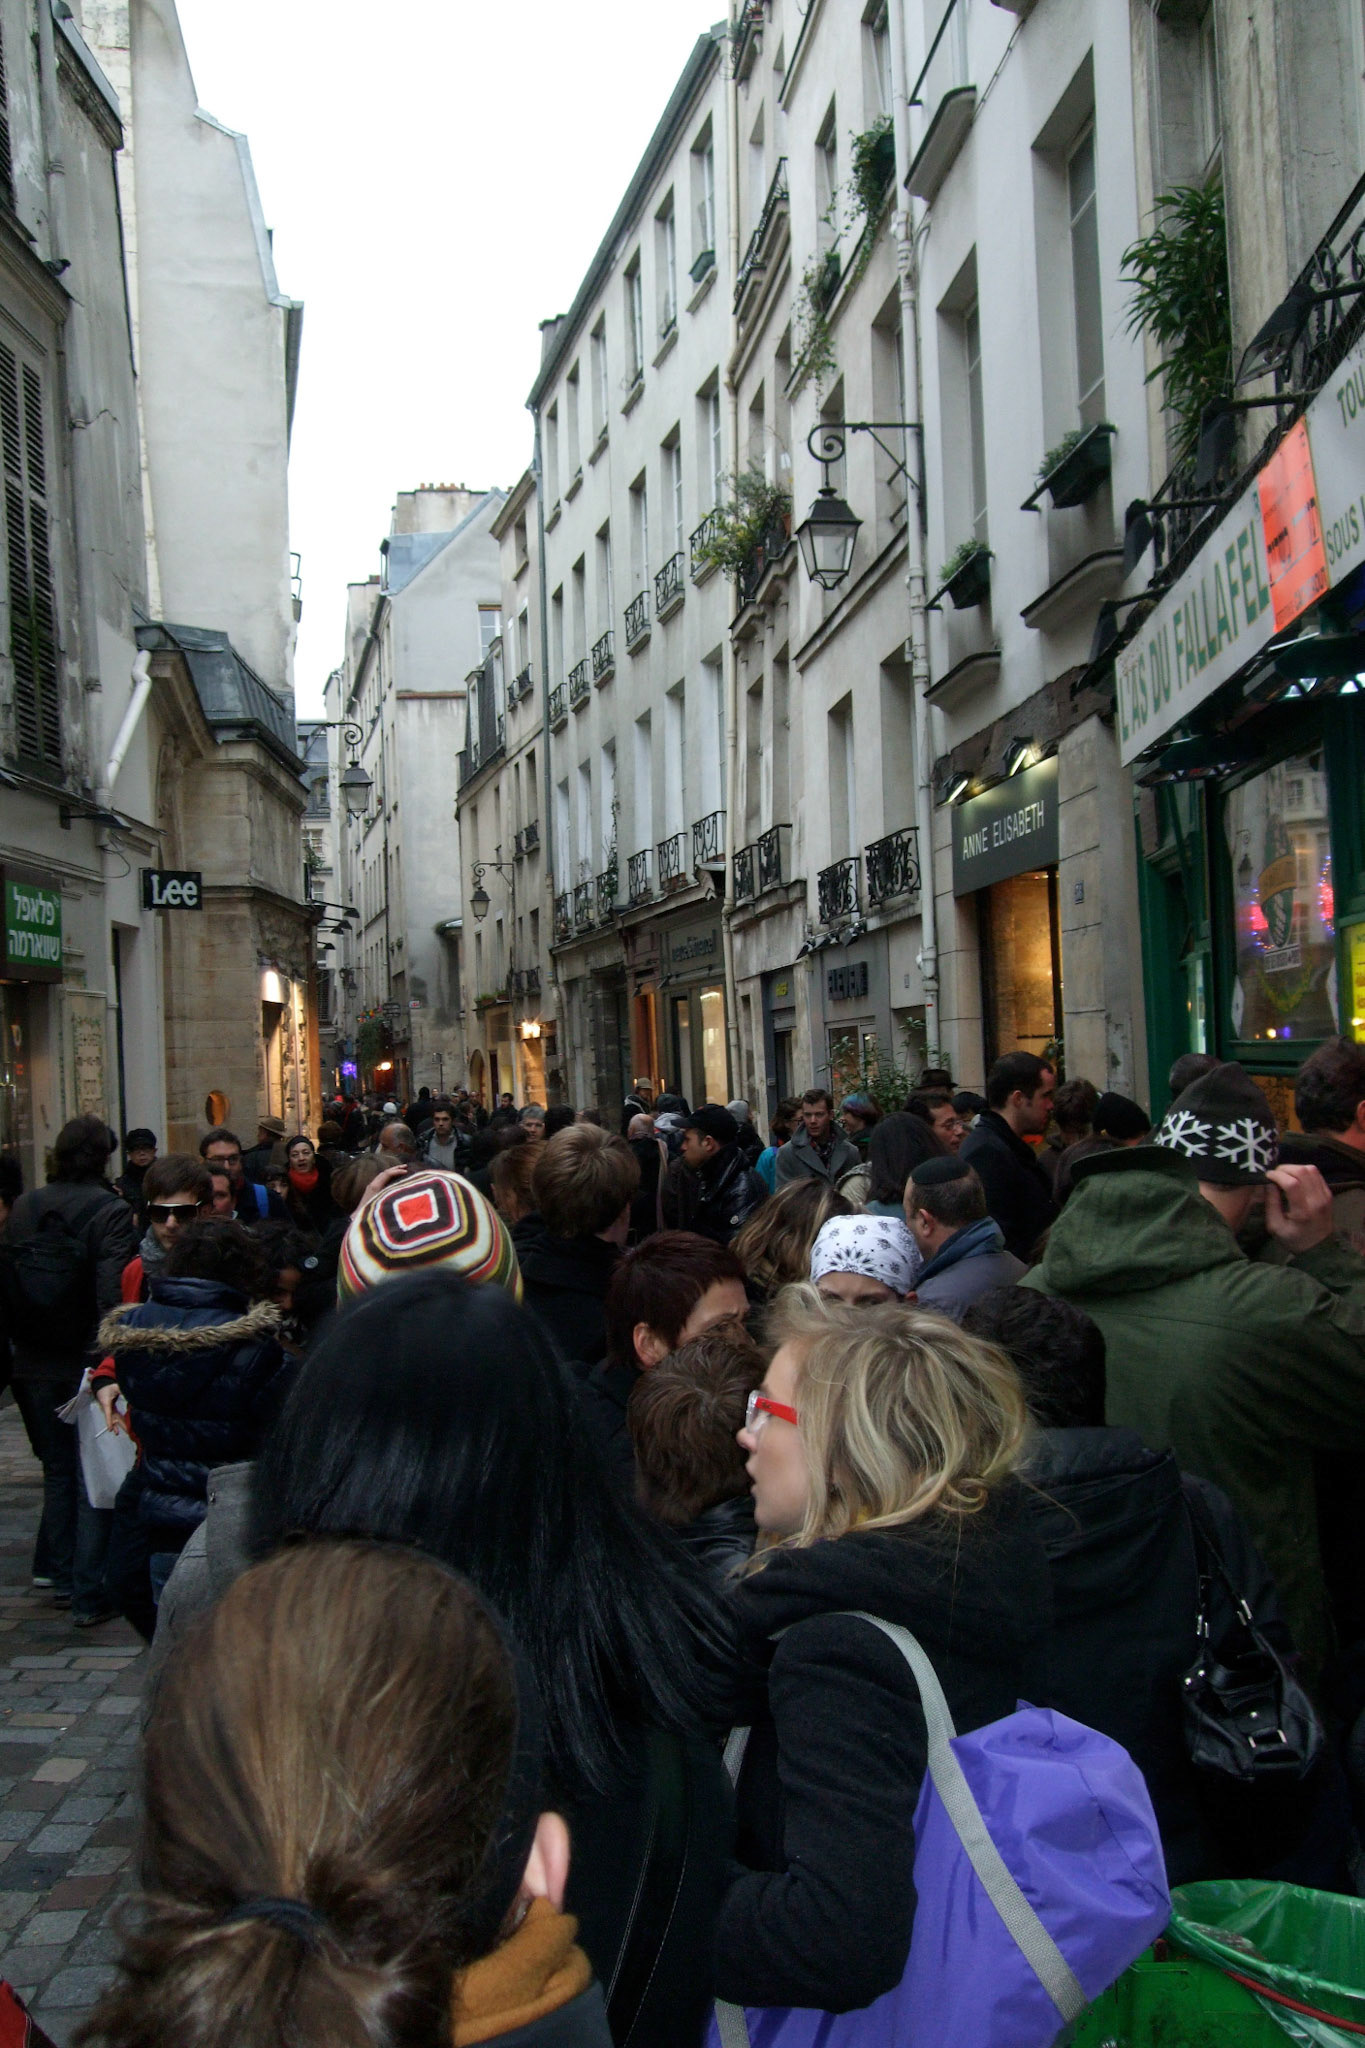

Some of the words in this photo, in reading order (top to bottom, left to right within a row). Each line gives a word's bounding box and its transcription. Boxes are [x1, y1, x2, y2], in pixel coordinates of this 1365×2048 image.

[1326, 504, 1360, 566] SOUS
[1119, 653, 1148, 743] L'AS
[1149, 624, 1171, 715] DU
[1173, 520, 1270, 691] FALLAFEL
[962, 826, 989, 860] ANNE
[993, 800, 1044, 847] ELISABETH
[13, 886, 56, 926] פלאפל
[151, 874, 198, 906] Lee
